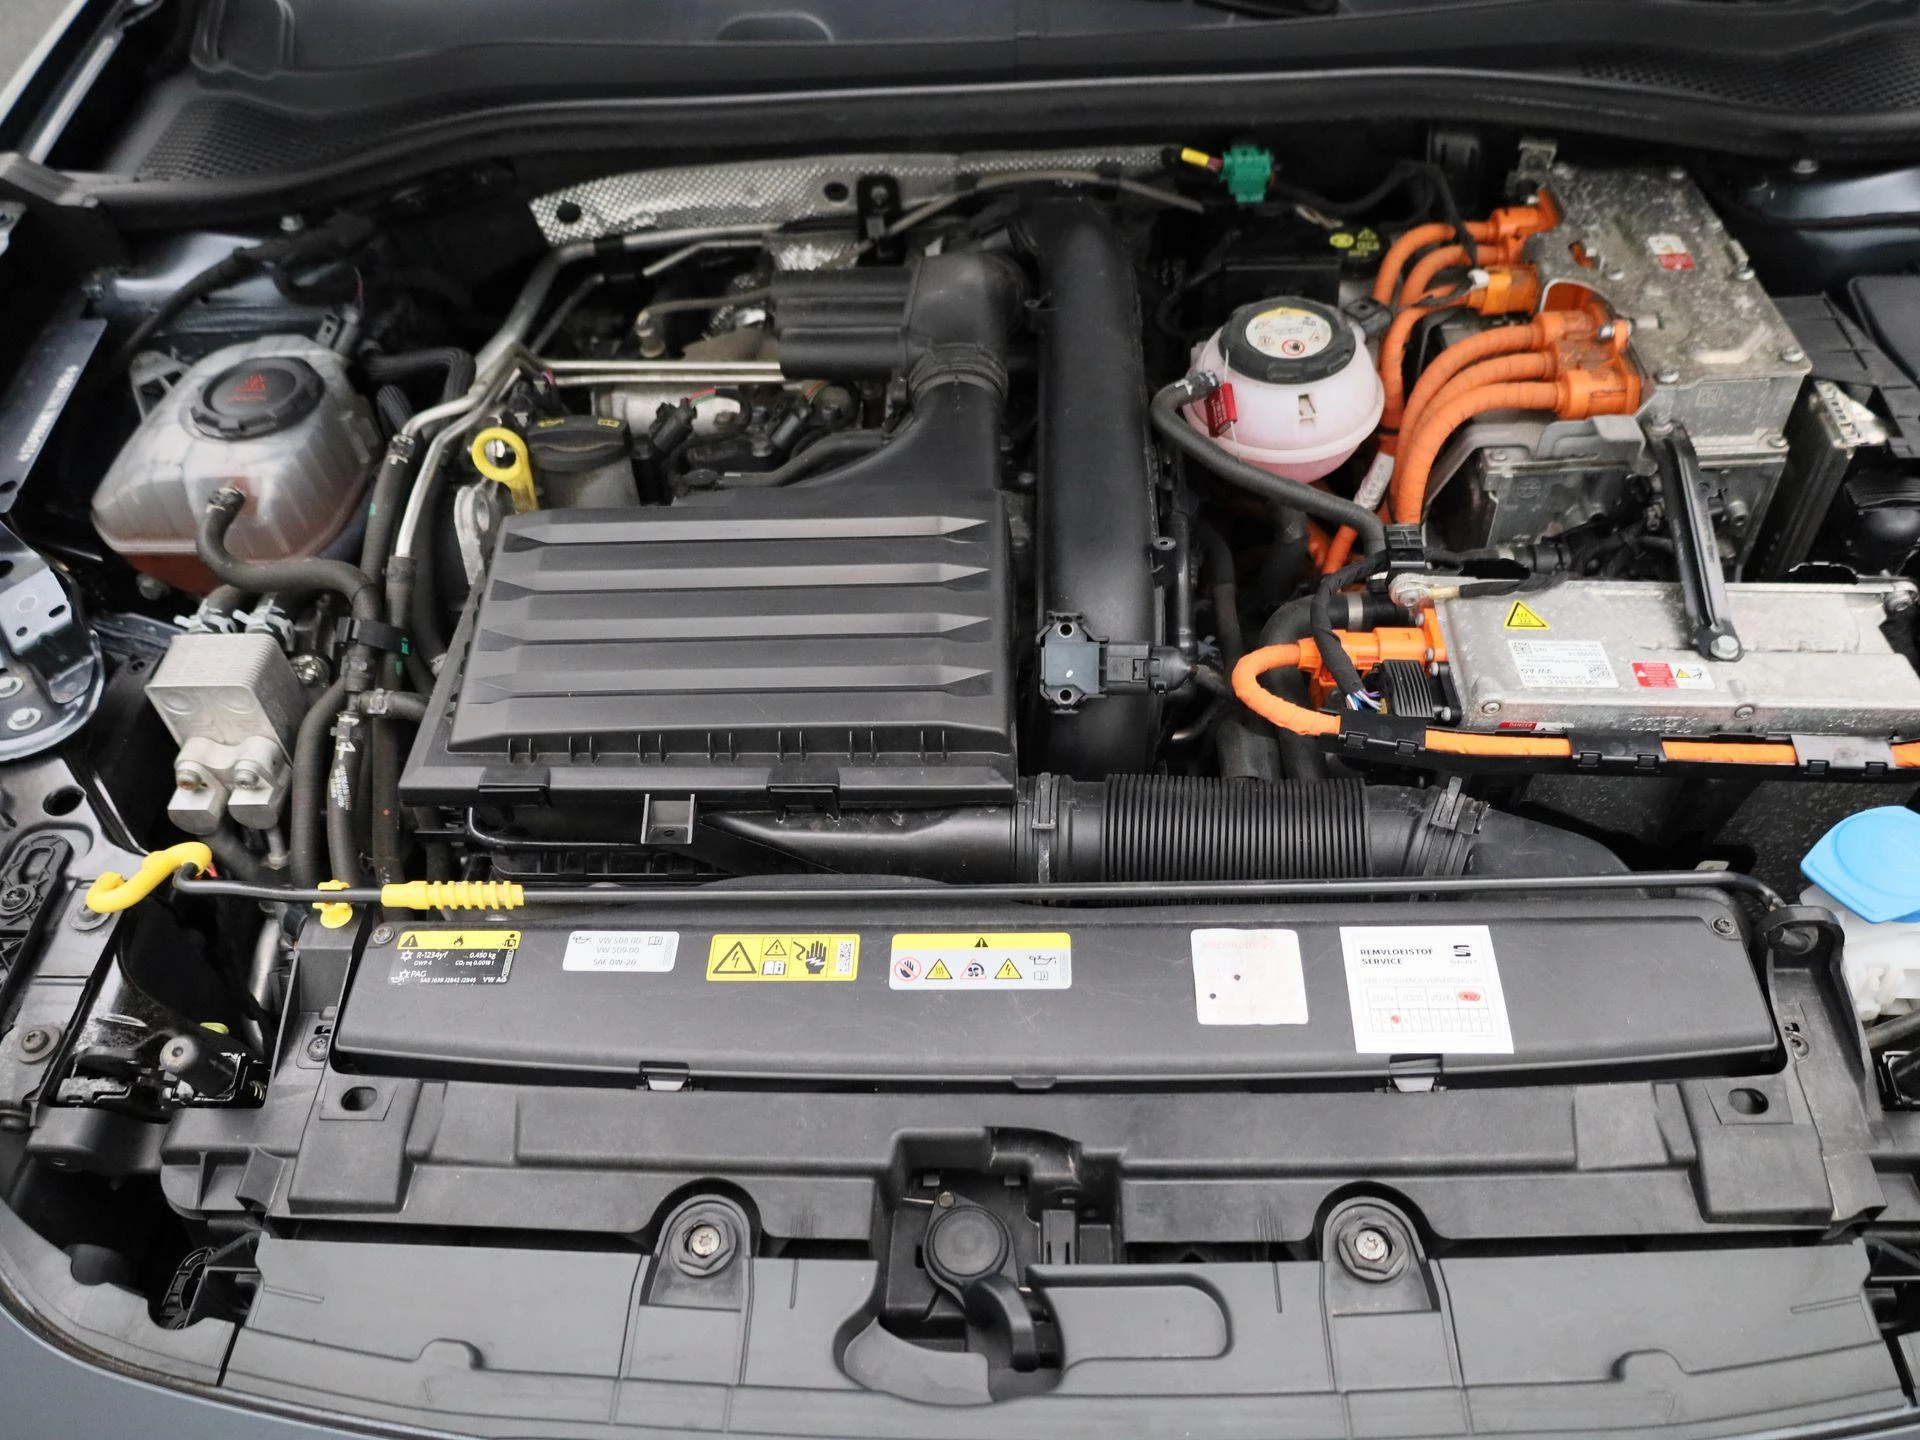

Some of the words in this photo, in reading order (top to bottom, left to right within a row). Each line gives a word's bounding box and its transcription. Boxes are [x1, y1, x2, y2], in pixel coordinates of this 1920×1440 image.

[598, 936, 612, 944] VW
[630, 936, 642, 944] 00
[596, 946, 610, 954] VW
[628, 946, 640, 954] 00
[1360, 948, 1434, 956] REMVLOEISTOF
[416, 951, 449, 961] R-1234yf
[488, 951, 497, 961] kg
[593, 958, 607, 966] SAE
[1361, 957, 1403, 965] SERVICE
[410, 970, 428, 978] PAG
